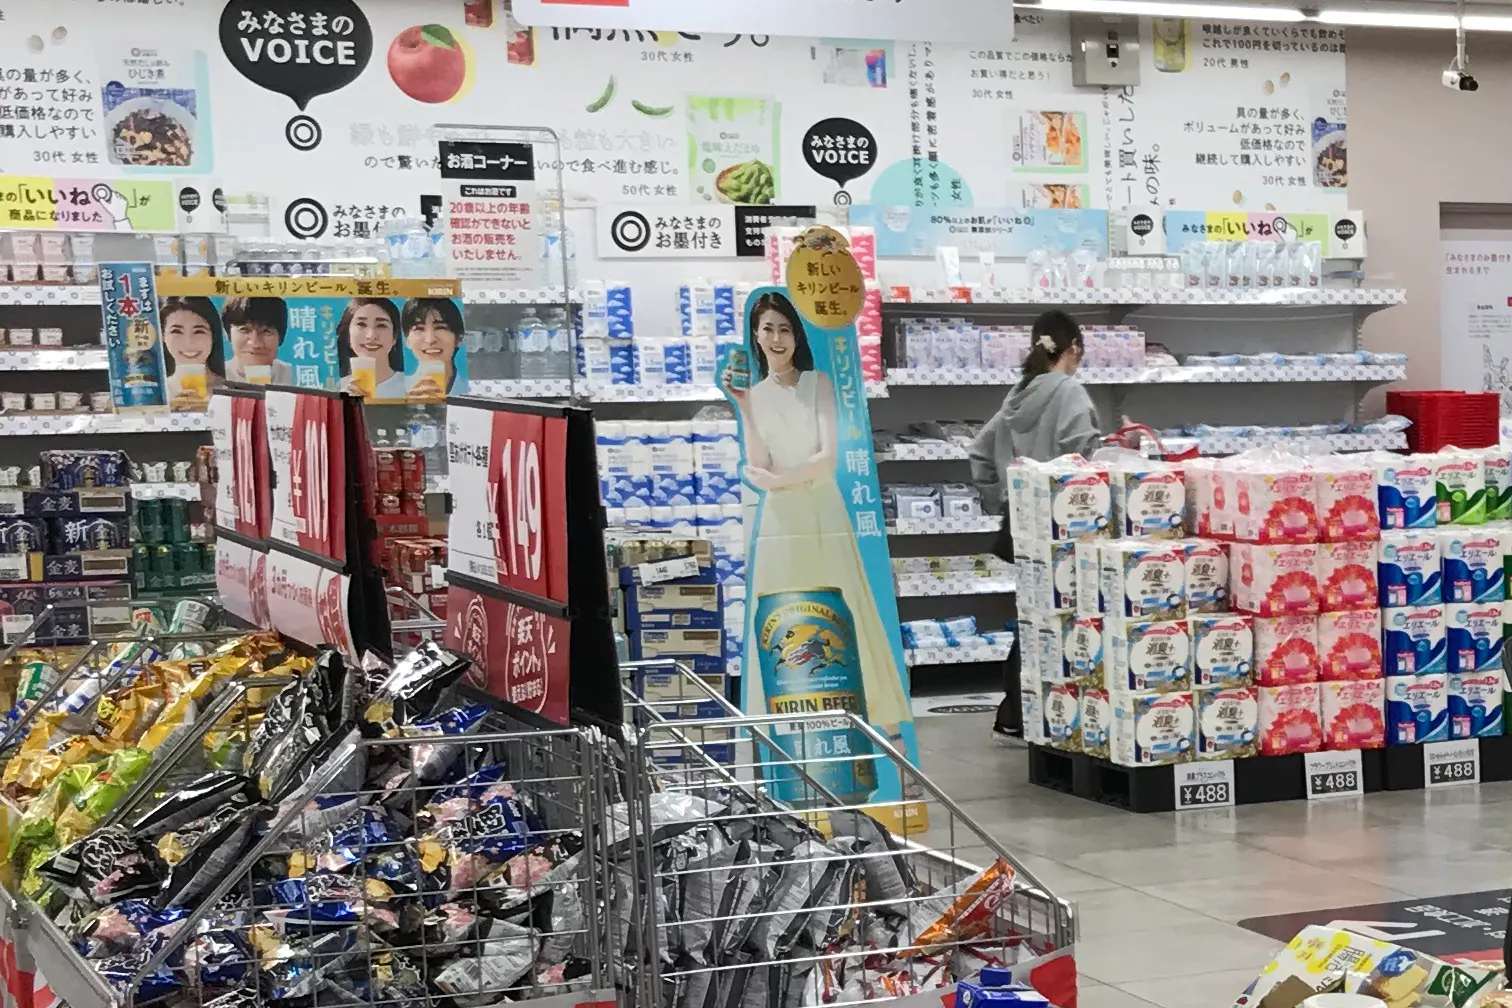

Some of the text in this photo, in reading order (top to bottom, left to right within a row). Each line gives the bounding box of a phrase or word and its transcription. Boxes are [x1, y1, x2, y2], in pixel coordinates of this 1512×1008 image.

[237, 11, 354, 35] みなさまの
[241, 38, 357, 67] VOICE
[640, 51, 694, 63] 30代 女性
[810, 135, 868, 150] みなさまの
[33, 150, 99, 164] 30代 女性
[447, 153, 528, 170] お酒コーナー
[812, 150, 868, 165] VOICE
[622, 184, 650, 196] 50代
[333, 205, 406, 219] みなさまの
[450, 201, 530, 215] 20歳以上の年齢
[9, 209, 103, 223] 商品になりました
[450, 217, 532, 230] 確認ができないと
[655, 216, 722, 230] みなさまの
[334, 220, 386, 239] お墨
[451, 233, 516, 246] お酒の販売を
[655, 231, 722, 250] お墨付き
[452, 249, 523, 261] いたしません。
[806, 262, 841, 276] 新しい
[139, 276, 153, 312] まずは
[215, 280, 454, 296] 新しいキリンビール、誕生。 KIRIN
[796, 281, 860, 296] キリンビール
[41, 496, 74, 512] 金麦
[64, 519, 89, 543] 新
[47, 559, 80, 575] 金麦
[776, 698, 818, 714] KIRIN
[1433, 762, 1473, 778] ¥488
[1314, 772, 1356, 789] ¥488
[1183, 784, 1227, 803] ¥488
